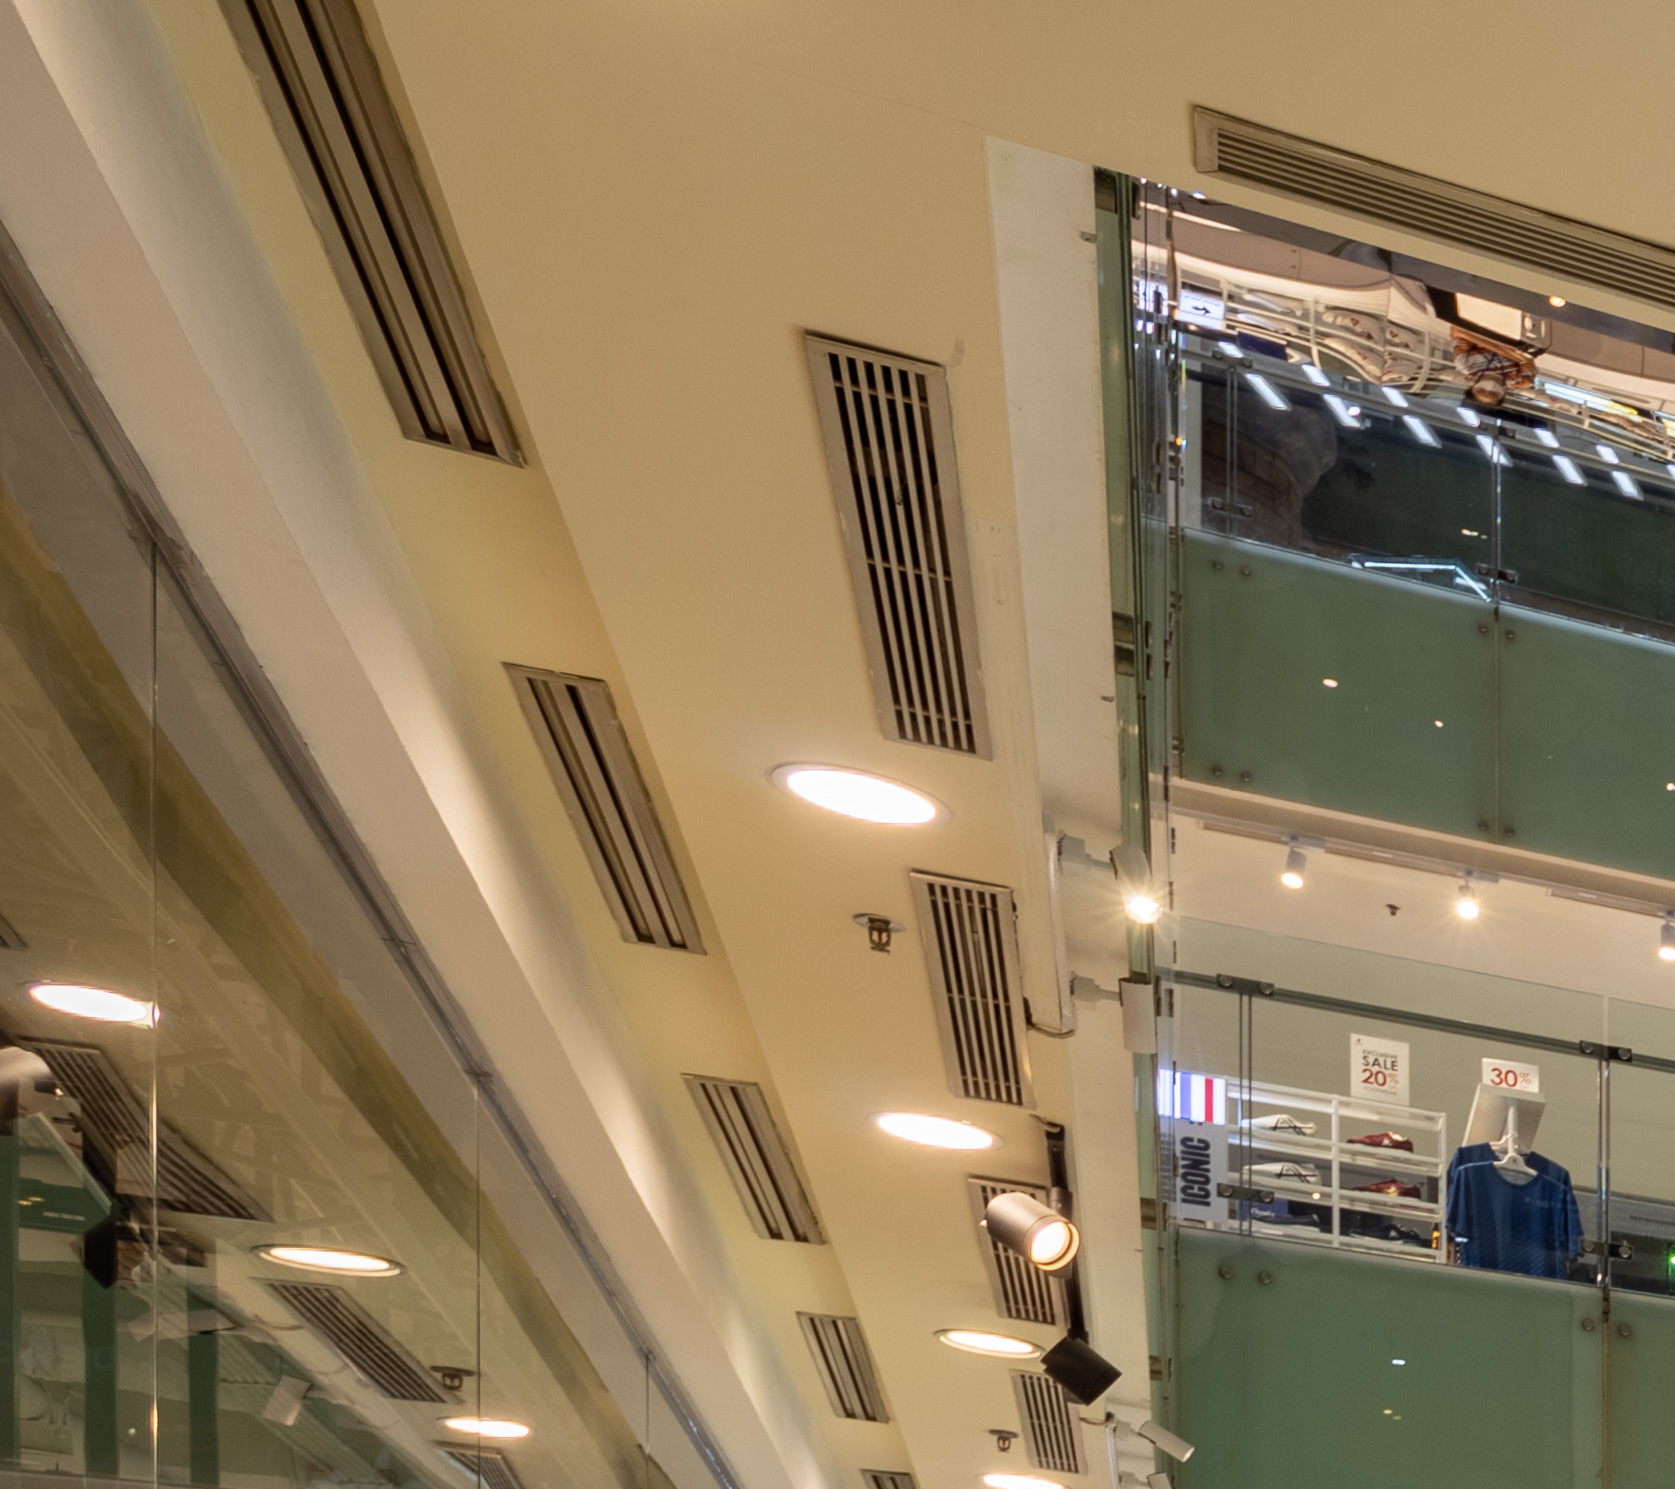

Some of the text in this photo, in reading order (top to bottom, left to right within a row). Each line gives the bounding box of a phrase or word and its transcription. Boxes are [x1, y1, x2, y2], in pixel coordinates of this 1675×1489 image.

[1361, 1055, 1400, 1073] SALE
[1361, 1067, 1400, 1088] 20%
[1489, 1066, 1532, 1089] 30%
[1179, 1136, 1212, 1208] ICONIC
